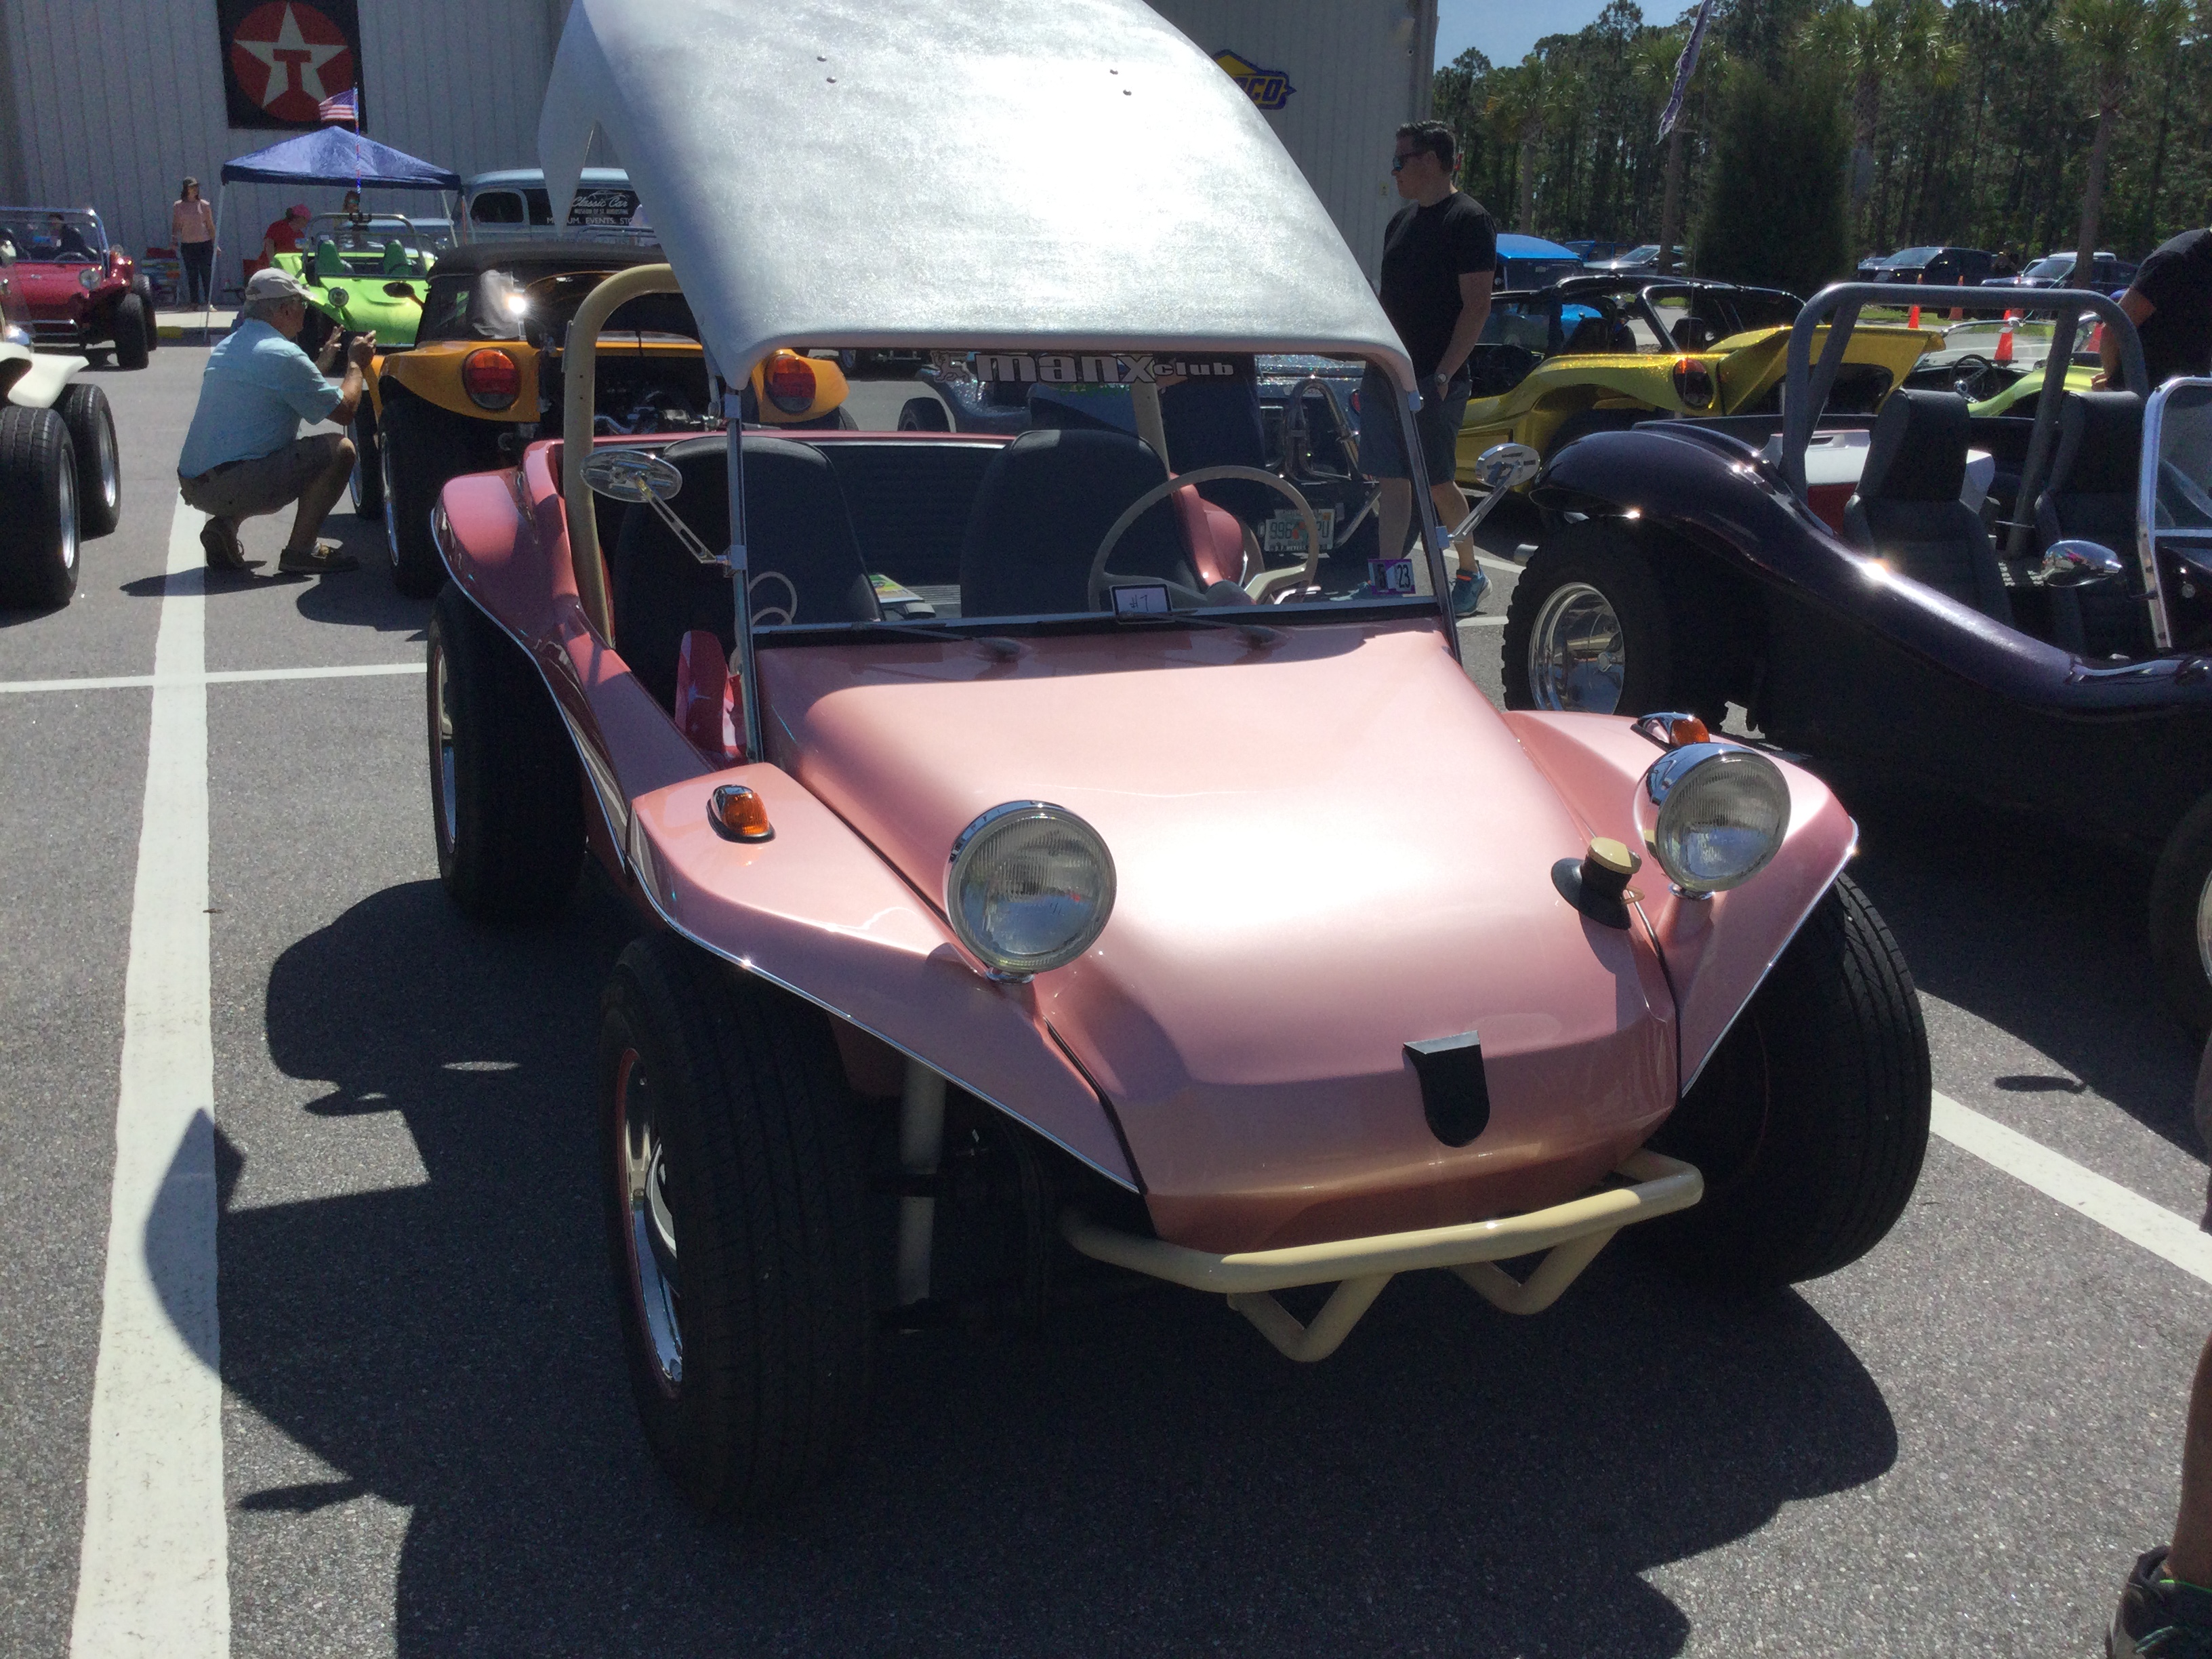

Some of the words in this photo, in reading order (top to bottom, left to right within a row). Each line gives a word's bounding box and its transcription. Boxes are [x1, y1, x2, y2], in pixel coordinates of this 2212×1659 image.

[273, 49, 312, 91] T
[572, 196, 607, 207] Classic
[609, 194, 628, 207] Car
[975, 353, 1156, 383] manx
[1153, 361, 1234, 376] club
[1397, 564, 1411, 588] 23
